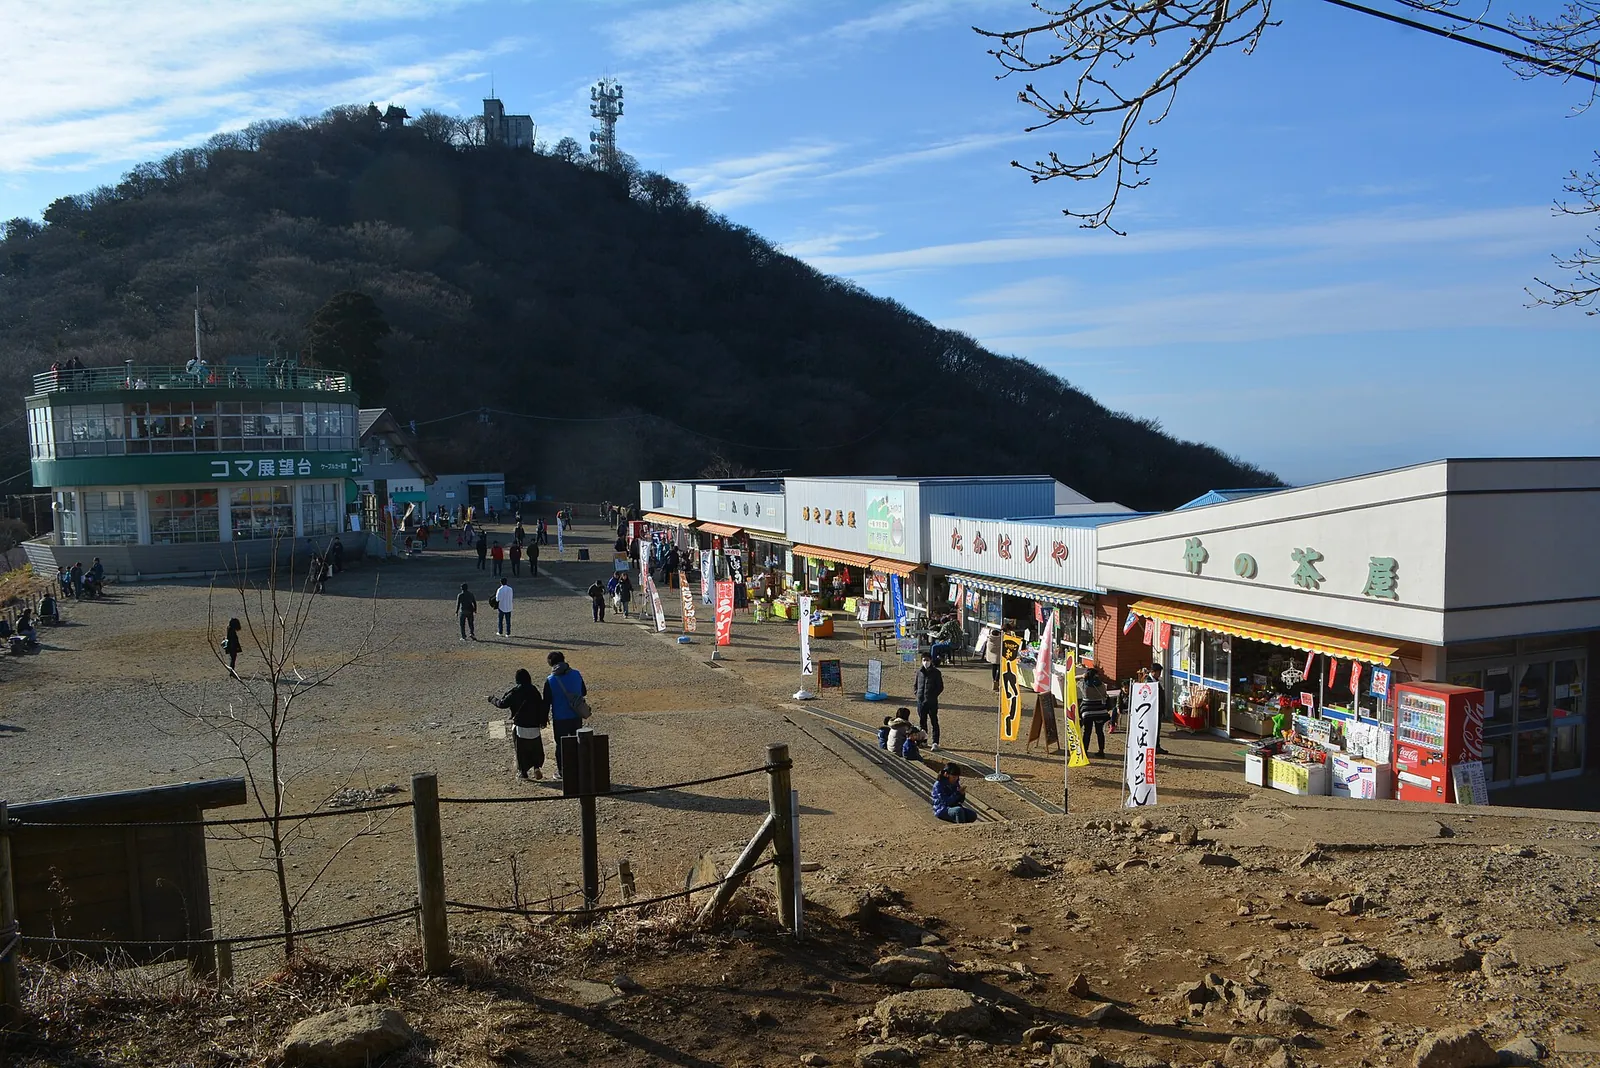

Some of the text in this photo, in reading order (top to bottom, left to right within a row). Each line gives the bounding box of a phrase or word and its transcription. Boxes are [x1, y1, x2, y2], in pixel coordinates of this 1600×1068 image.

[211, 458, 311, 477] コマ展望台
[951, 527, 1069, 567] たかはしや
[1183, 537, 1400, 602] 仲の茶屋
[1132, 702, 1153, 806] つくばうどん
